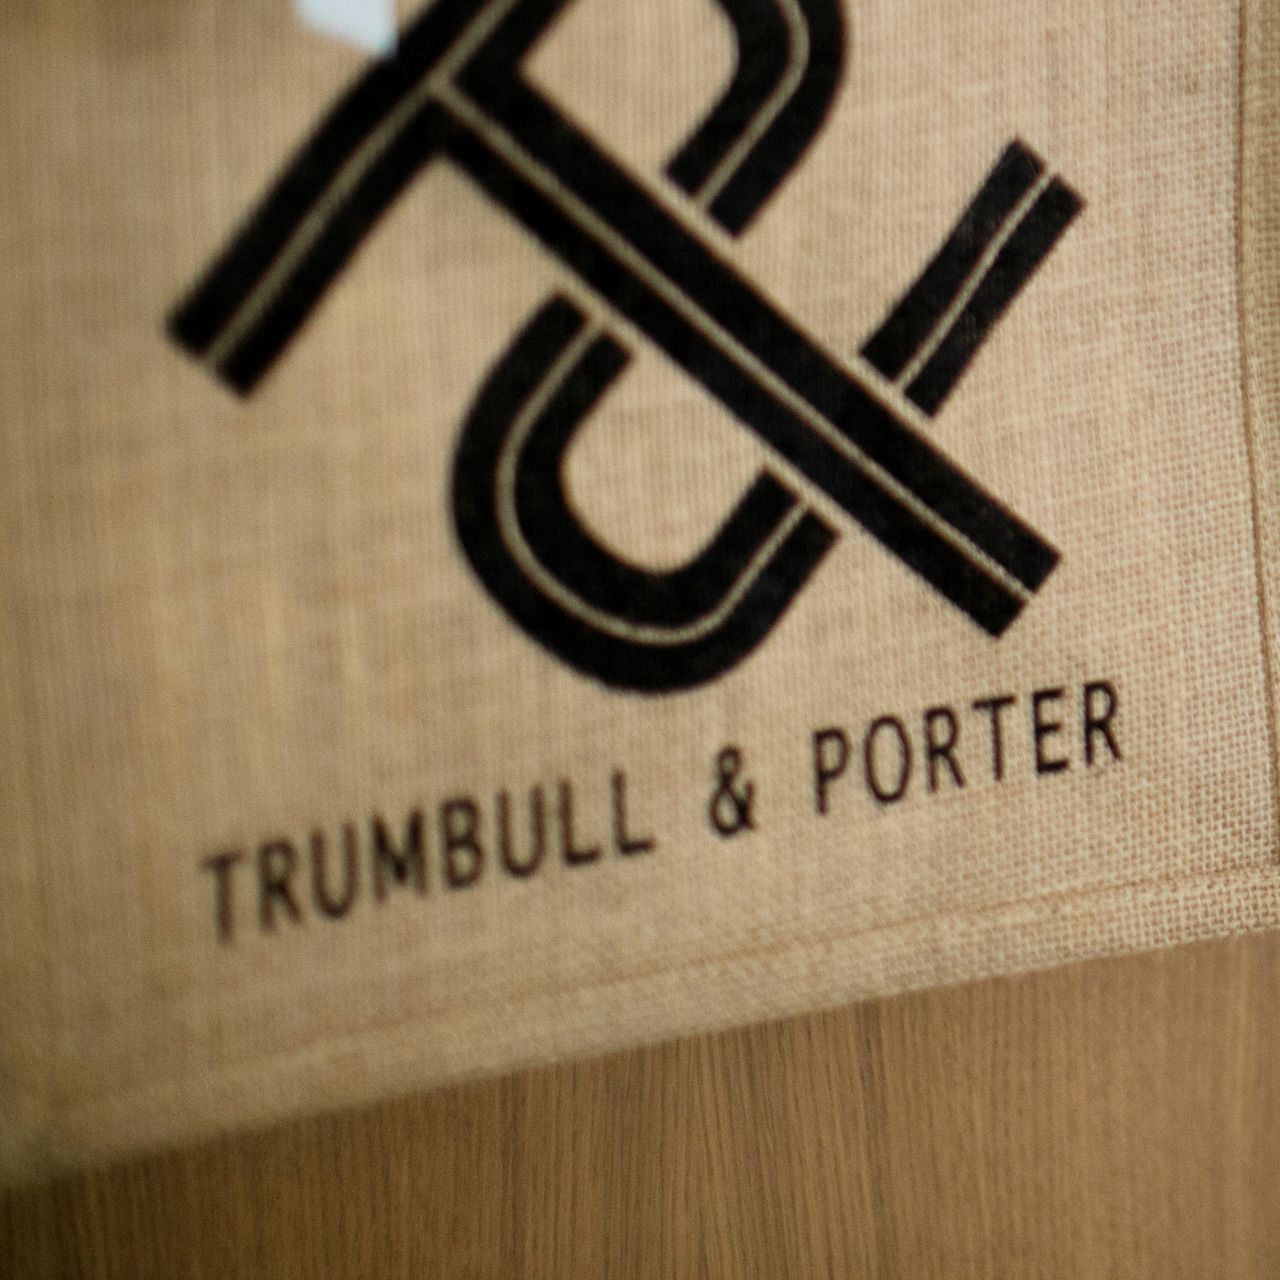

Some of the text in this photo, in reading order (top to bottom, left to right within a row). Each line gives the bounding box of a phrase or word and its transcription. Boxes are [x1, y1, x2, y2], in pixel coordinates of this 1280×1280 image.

[200, 678, 1125, 948] TRUMBULL & PORTER
